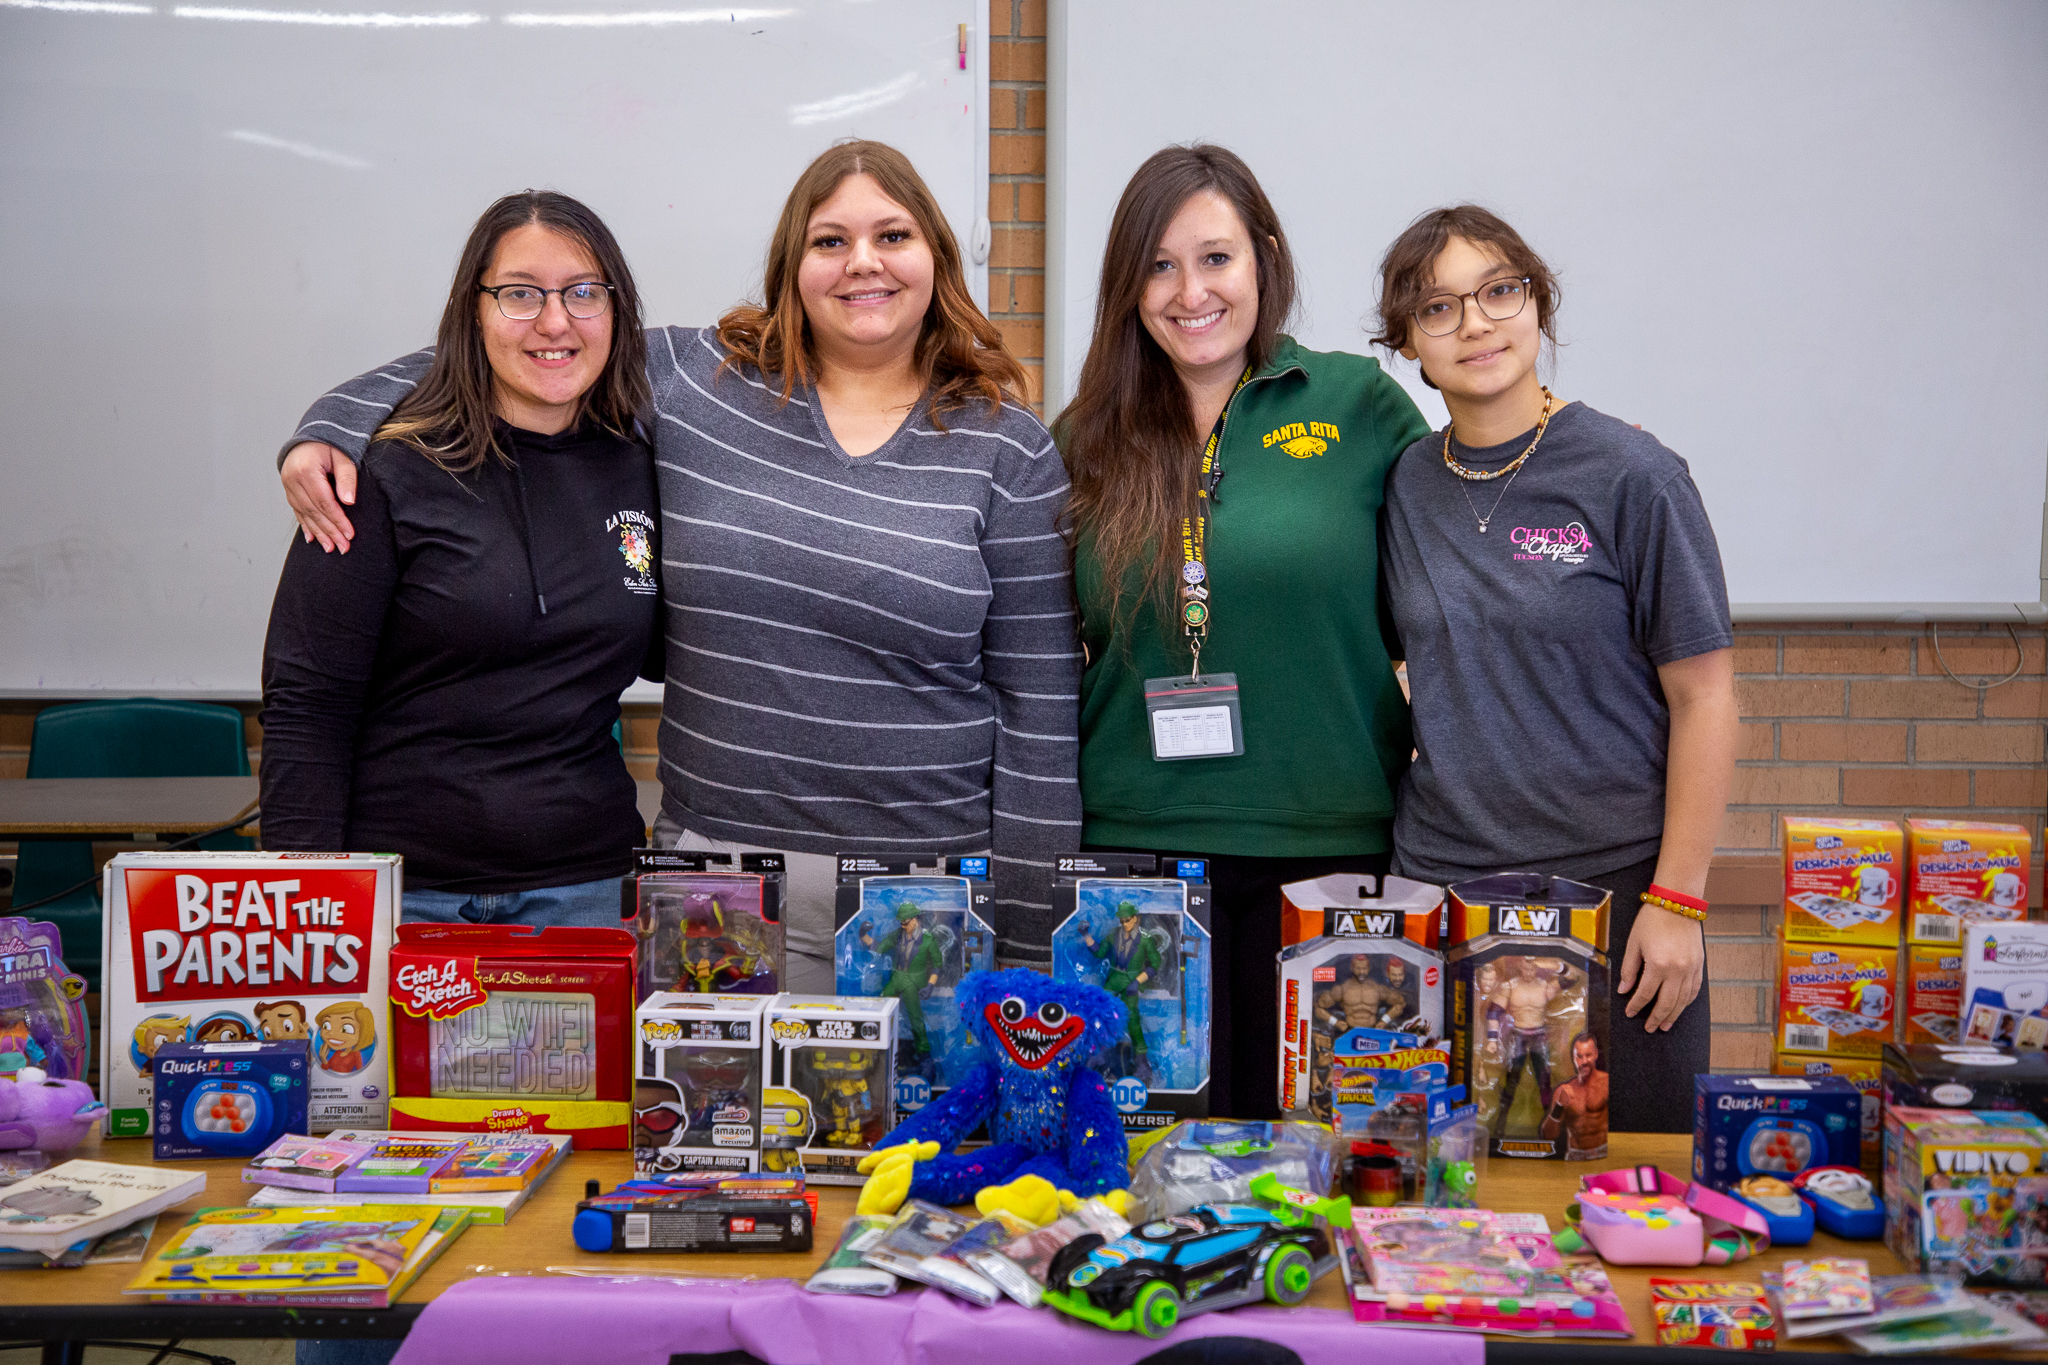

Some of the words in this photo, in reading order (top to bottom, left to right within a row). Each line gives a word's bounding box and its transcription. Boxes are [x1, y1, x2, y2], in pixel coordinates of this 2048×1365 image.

[1262, 422, 1308, 448] SANTA
[1309, 421, 1340, 443] RITA
[1205, 432, 1218, 457] SANTA
[1202, 456, 1213, 474] RITA
[605, 514, 619, 532] LA
[1510, 526, 1579, 544] CHICKS
[1521, 542, 1528, 550] n
[1513, 553, 1544, 561] TUCSON
[639, 855, 654, 866] 14
[761, 859, 779, 867] 12+
[841, 859, 856, 871] 22
[1058, 858, 1074, 871] 22
[1793, 851, 1893, 871] DESIGN-A-MUG
[1919, 856, 2021, 874] DESIGN-A-MUG
[175, 874, 300, 933] BEAT
[292, 896, 346, 927] THE
[975, 895, 989, 904] 12+
[1191, 896, 1205, 906] 12+
[1337, 915, 1392, 934] AEW
[1502, 910, 1557, 932] AEW
[142, 929, 364, 993] PARENTS
[5, 968, 46, 984] MINIS
[397, 965, 437, 990] Etch
[439, 959, 458, 985] A
[508, 971, 552, 985] Sketch
[1788, 967, 1889, 985] DESIGN-A-MUG
[412, 977, 471, 1009] Sketch
[1285, 978, 1299, 1043] OMEGA
[1454, 980, 1466, 1026] CAGE
[437, 1004, 489, 1046] NO
[502, 1001, 589, 1049] WIFI
[641, 1022, 681, 1041] POP!
[770, 1021, 810, 1040] POP!
[816, 1027, 855, 1039] WARS
[820, 1021, 853, 1031] STAR
[273, 1075, 287, 1083] 999
[438, 1046, 589, 1095] NEEDED
[1283, 1045, 1297, 1110] KENNY
[897, 1083, 930, 1104] DC
[1113, 1085, 1146, 1106] DC
[1337, 1093, 1375, 1104] TRUCKS
[324, 1106, 363, 1114] ATTENTION
[492, 1110, 515, 1118] Draw
[515, 1108, 524, 1117] &
[486, 1115, 529, 1129] Shake
[1118, 1115, 1175, 1126] IVERSE
[714, 1127, 751, 1136] amazon
[375, 1144, 459, 1152] ENGLISH
[683, 1156, 713, 1165] CAPTAIN
[714, 1157, 746, 1167] AMERICA
[827, 1156, 856, 1166] NED-B
[1934, 1151, 2031, 1173] VIDIYO
[284, 1294, 316, 1303] Rainbow
[317, 1295, 346, 1304] Scratch
[1653, 1283, 1766, 1300] UNO
